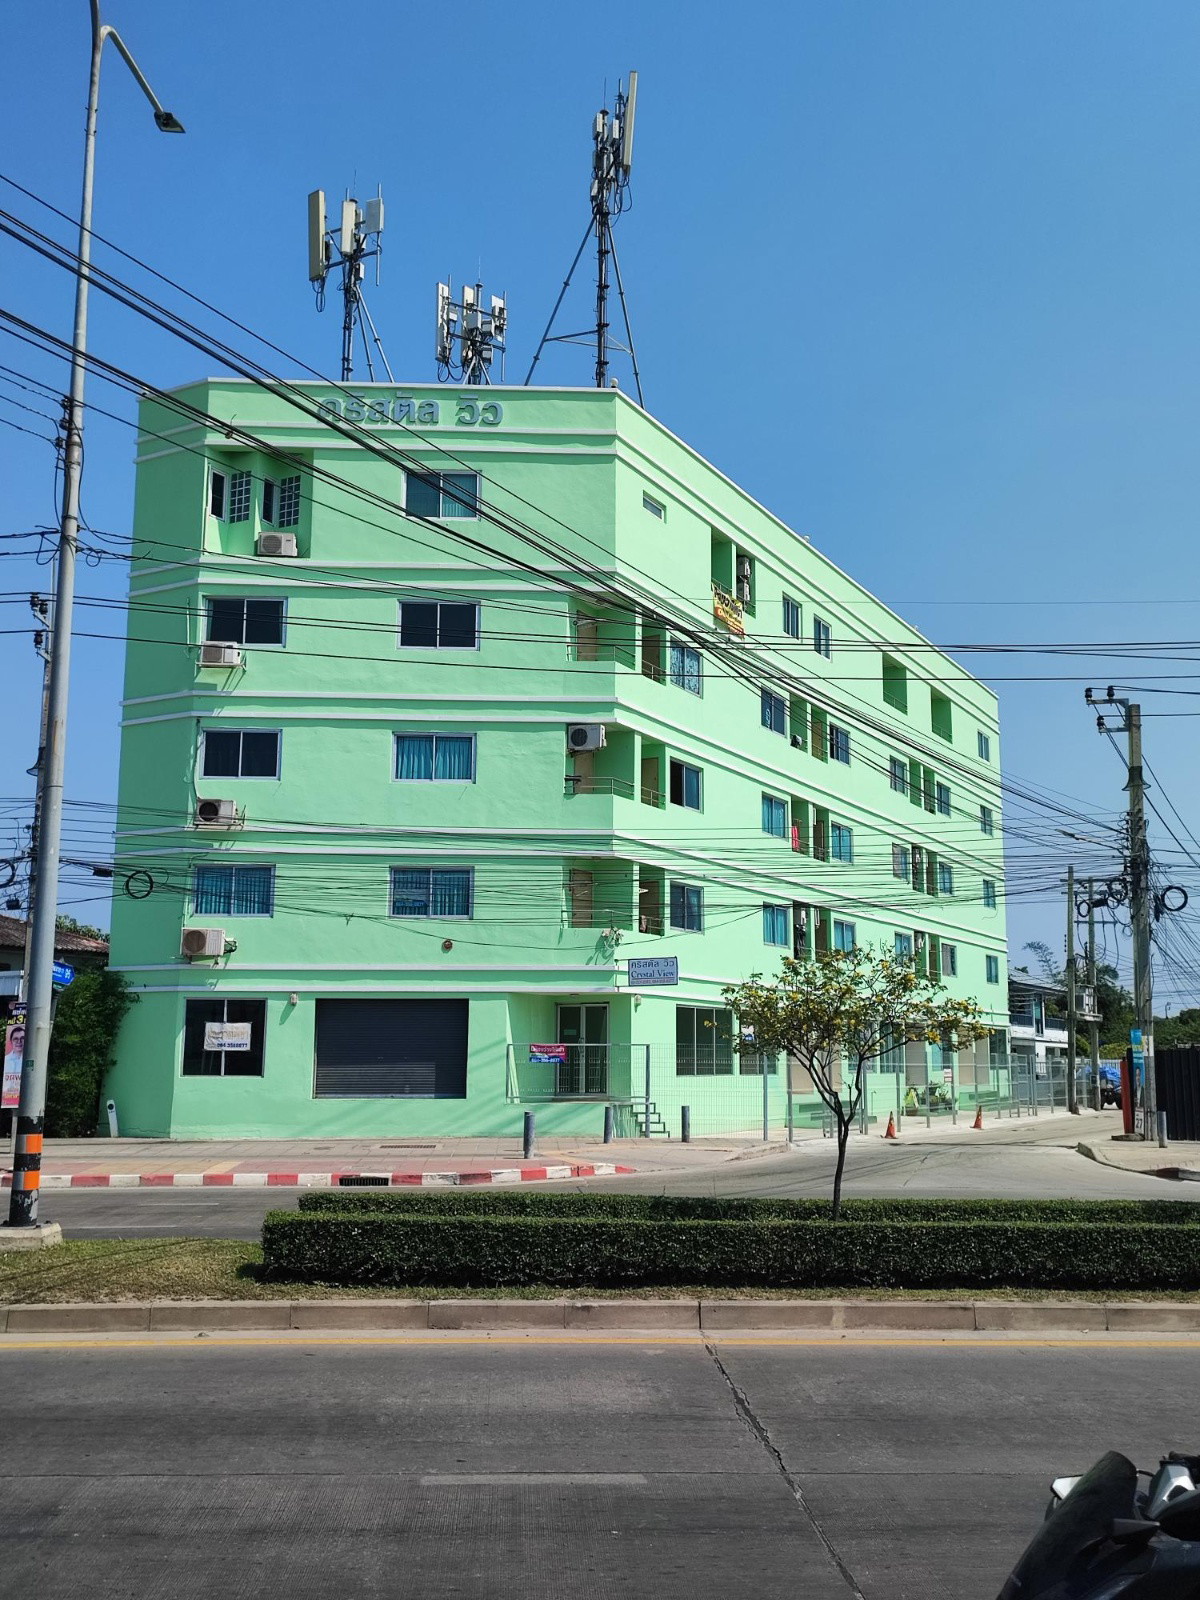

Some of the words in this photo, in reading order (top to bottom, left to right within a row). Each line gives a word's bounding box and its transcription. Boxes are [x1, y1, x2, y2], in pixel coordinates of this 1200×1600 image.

[317, 391, 440, 424] คริสตัล
[458, 394, 504, 424] วิว
[631, 969, 656, 978] Crystal
[657, 969, 675, 977] View
